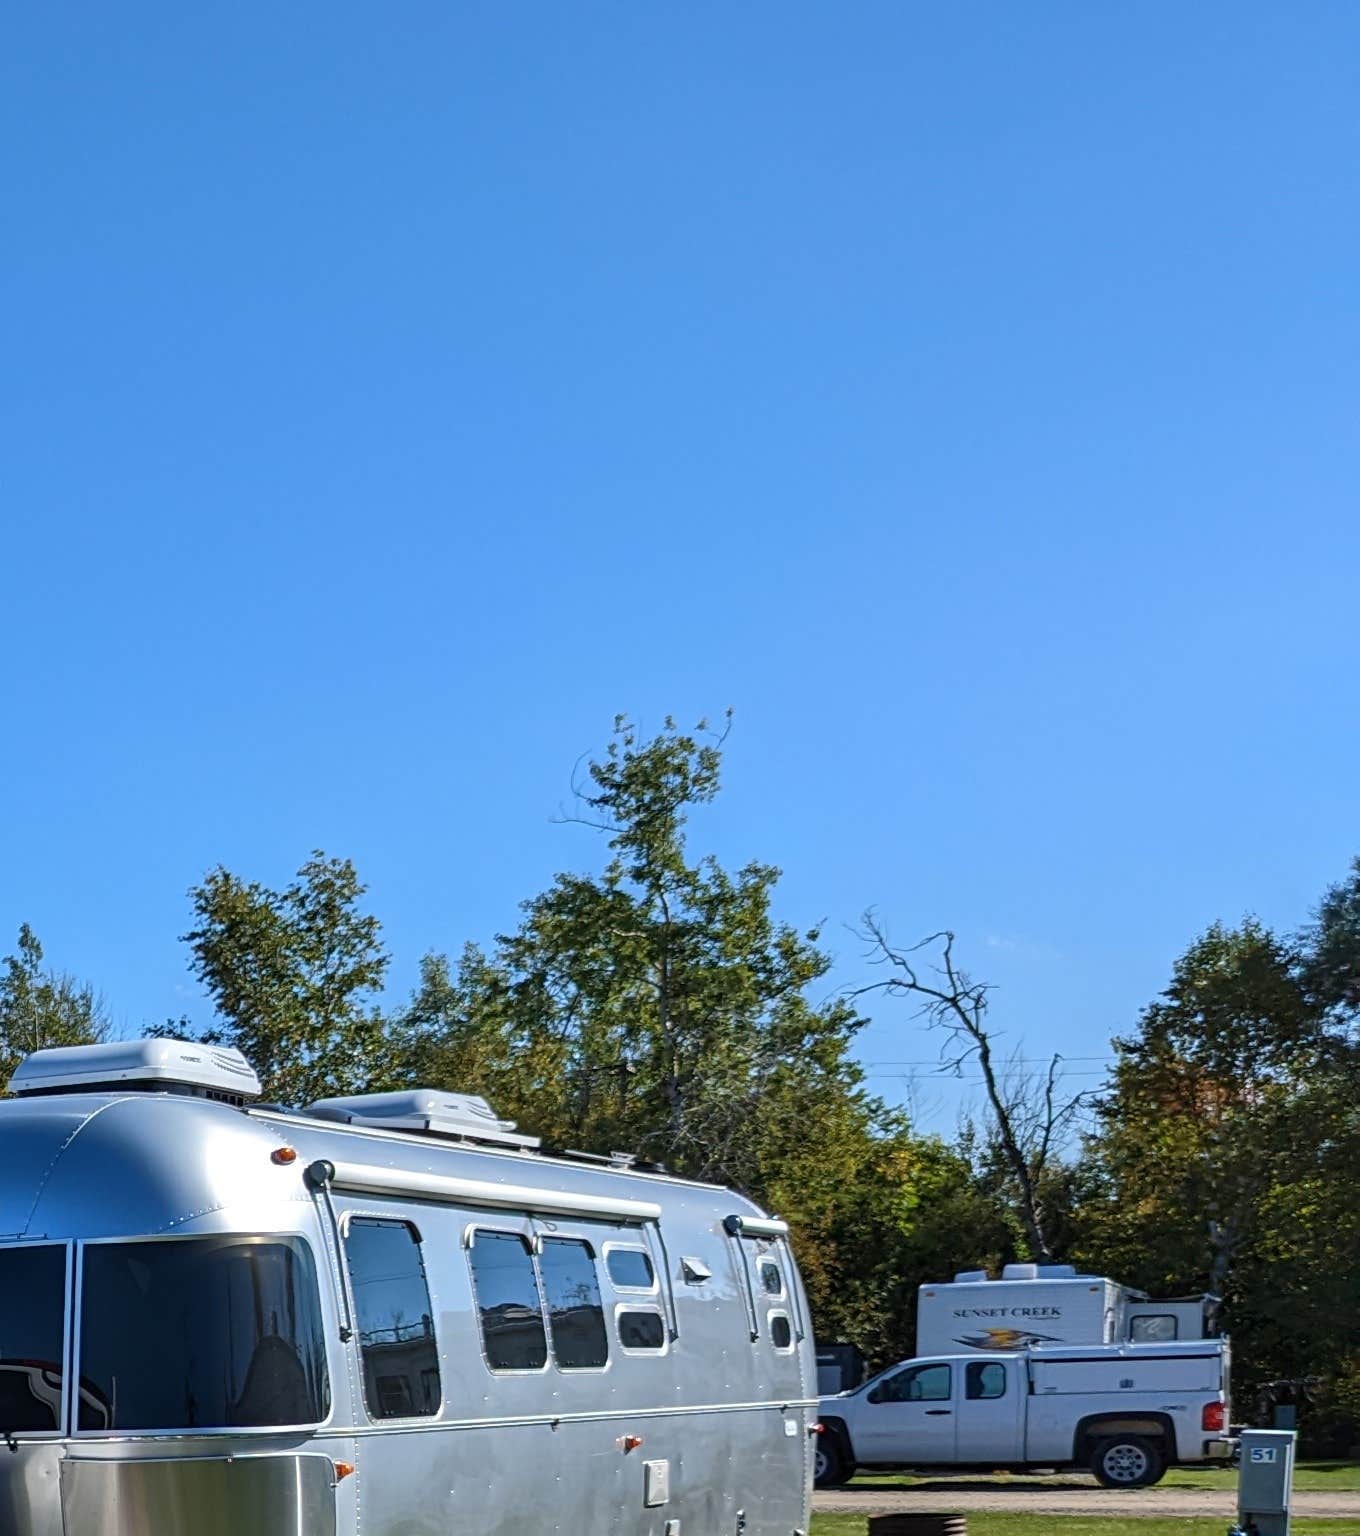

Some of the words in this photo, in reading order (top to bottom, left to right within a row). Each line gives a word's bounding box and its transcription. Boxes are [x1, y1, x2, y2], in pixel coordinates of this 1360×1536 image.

[952, 1308, 1008, 1319] SUNSET
[1010, 1306, 1062, 1317] CREEK
[1252, 1449, 1274, 1461] 51
